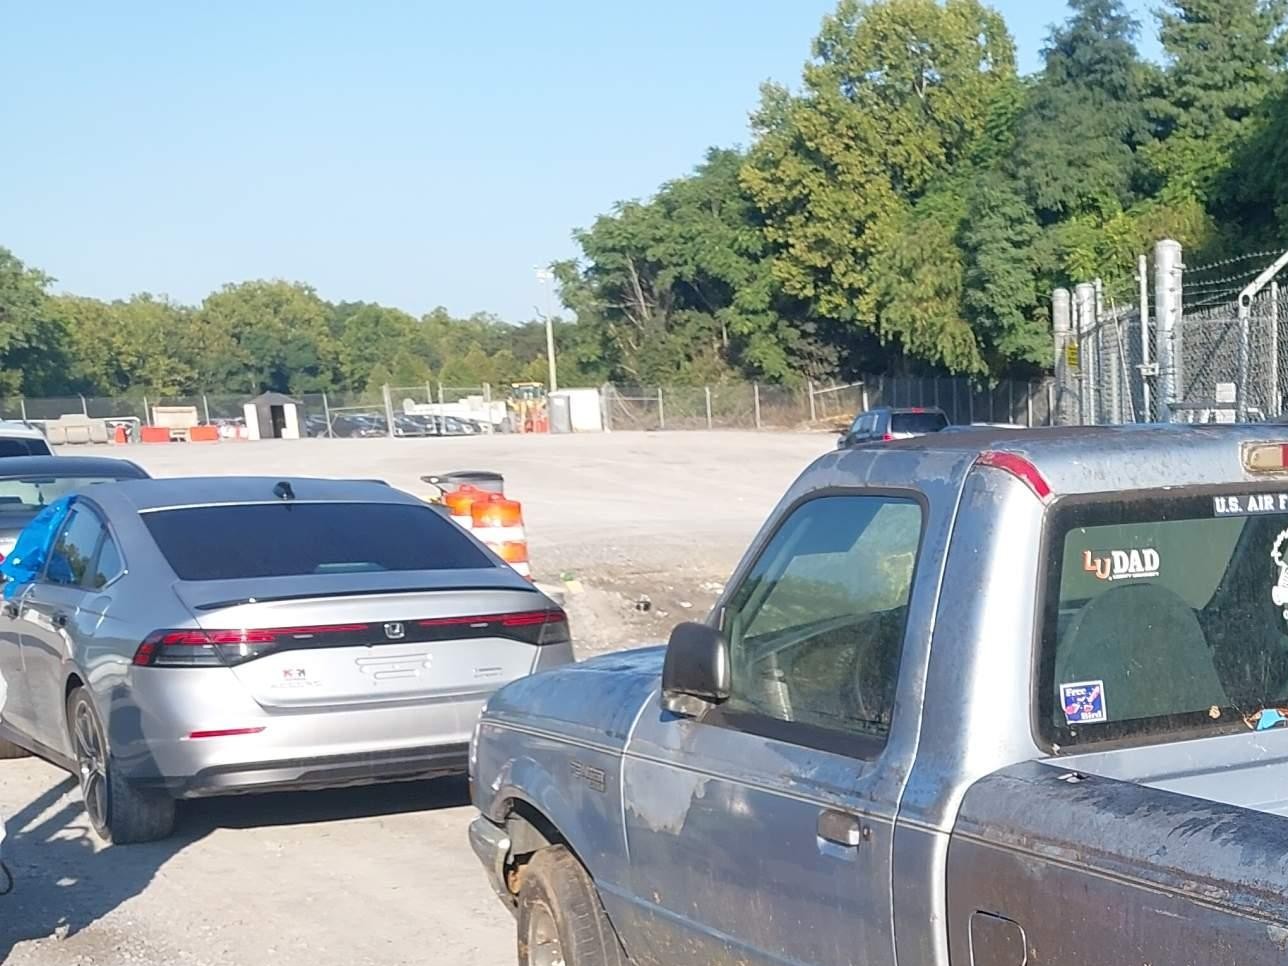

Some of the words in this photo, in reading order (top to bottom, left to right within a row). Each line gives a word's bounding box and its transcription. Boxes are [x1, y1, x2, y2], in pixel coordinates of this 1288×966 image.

[1215, 496, 1242, 513] U.S.
[1247, 494, 1274, 512] AIR
[1111, 548, 1160, 574] DAD
[1065, 688, 1087, 697] Free
[1080, 710, 1102, 720] Bird
